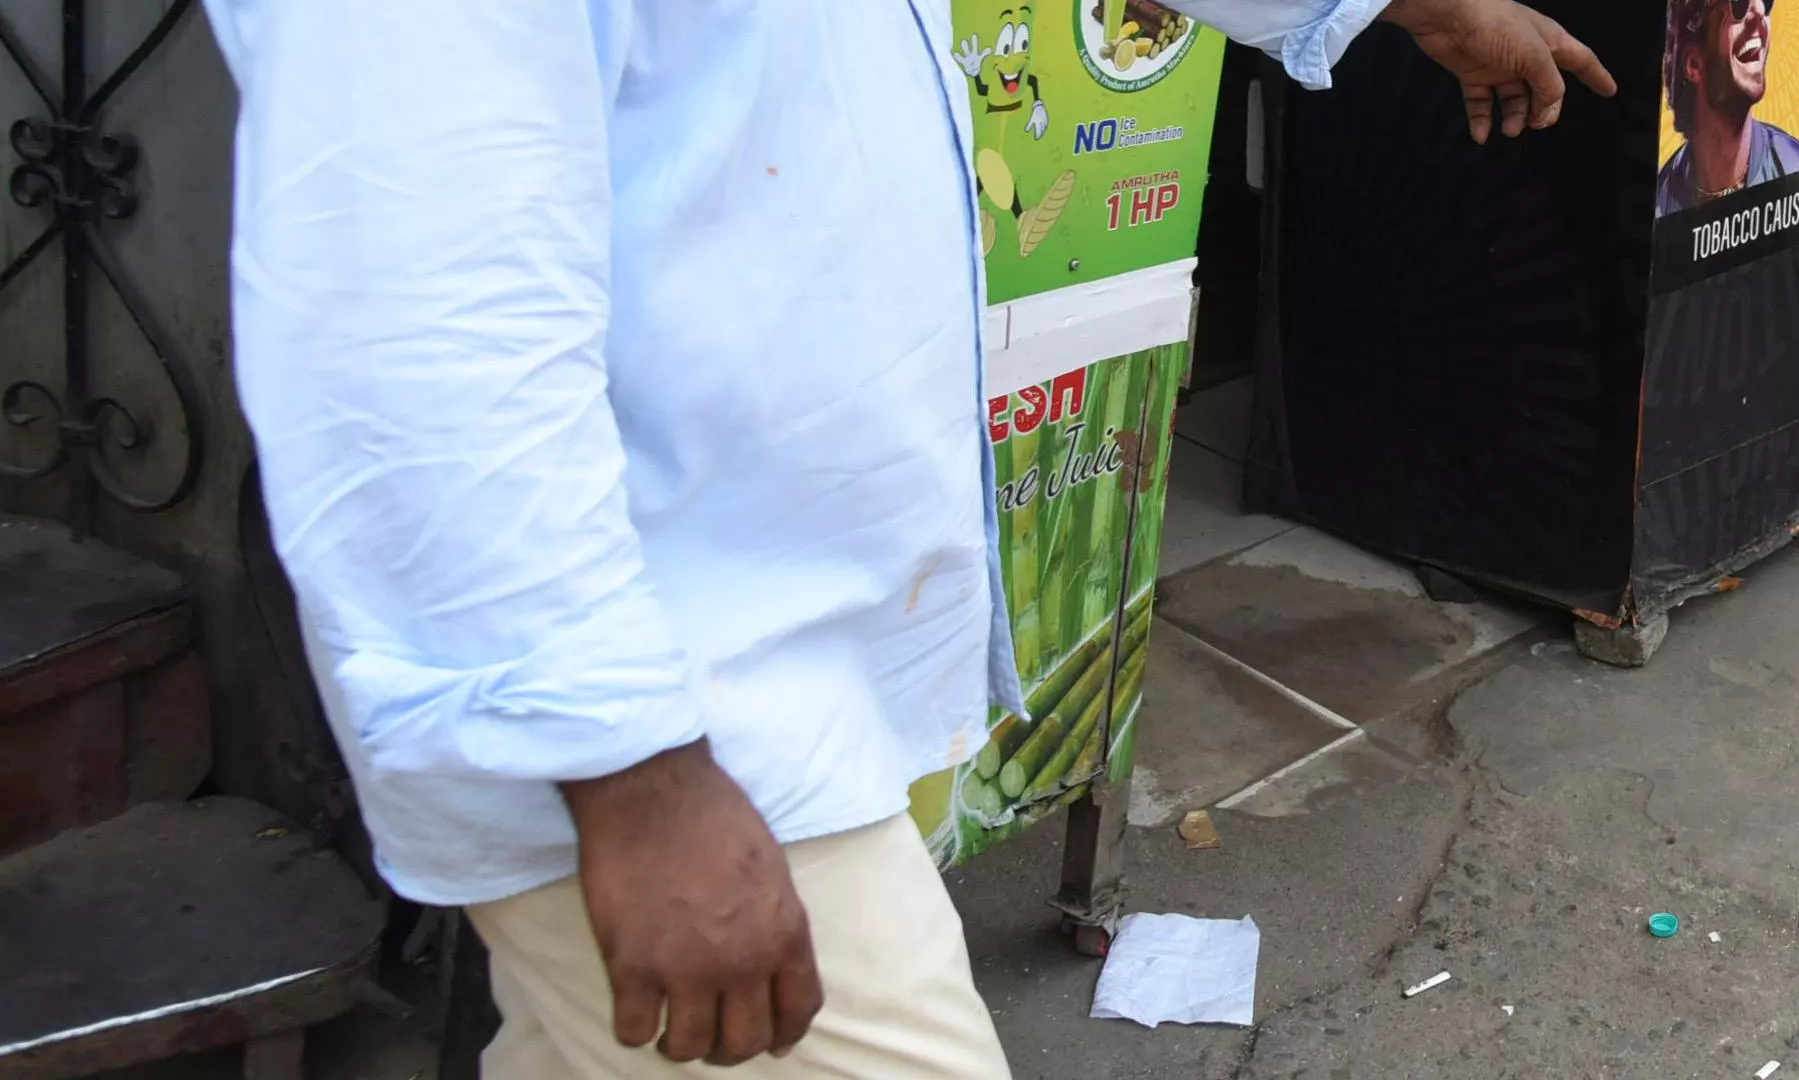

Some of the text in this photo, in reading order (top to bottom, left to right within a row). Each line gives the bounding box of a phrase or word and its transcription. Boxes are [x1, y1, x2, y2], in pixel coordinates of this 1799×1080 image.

[1073, 117, 1137, 155] NO Ice
[1118, 127, 1183, 149] Contamination
[1111, 170, 1180, 191] AMRUTHA
[1106, 182, 1180, 232] 1 HP
[1692, 206, 1761, 261] TOBACCO
[1046, 423, 1123, 498] Juic
